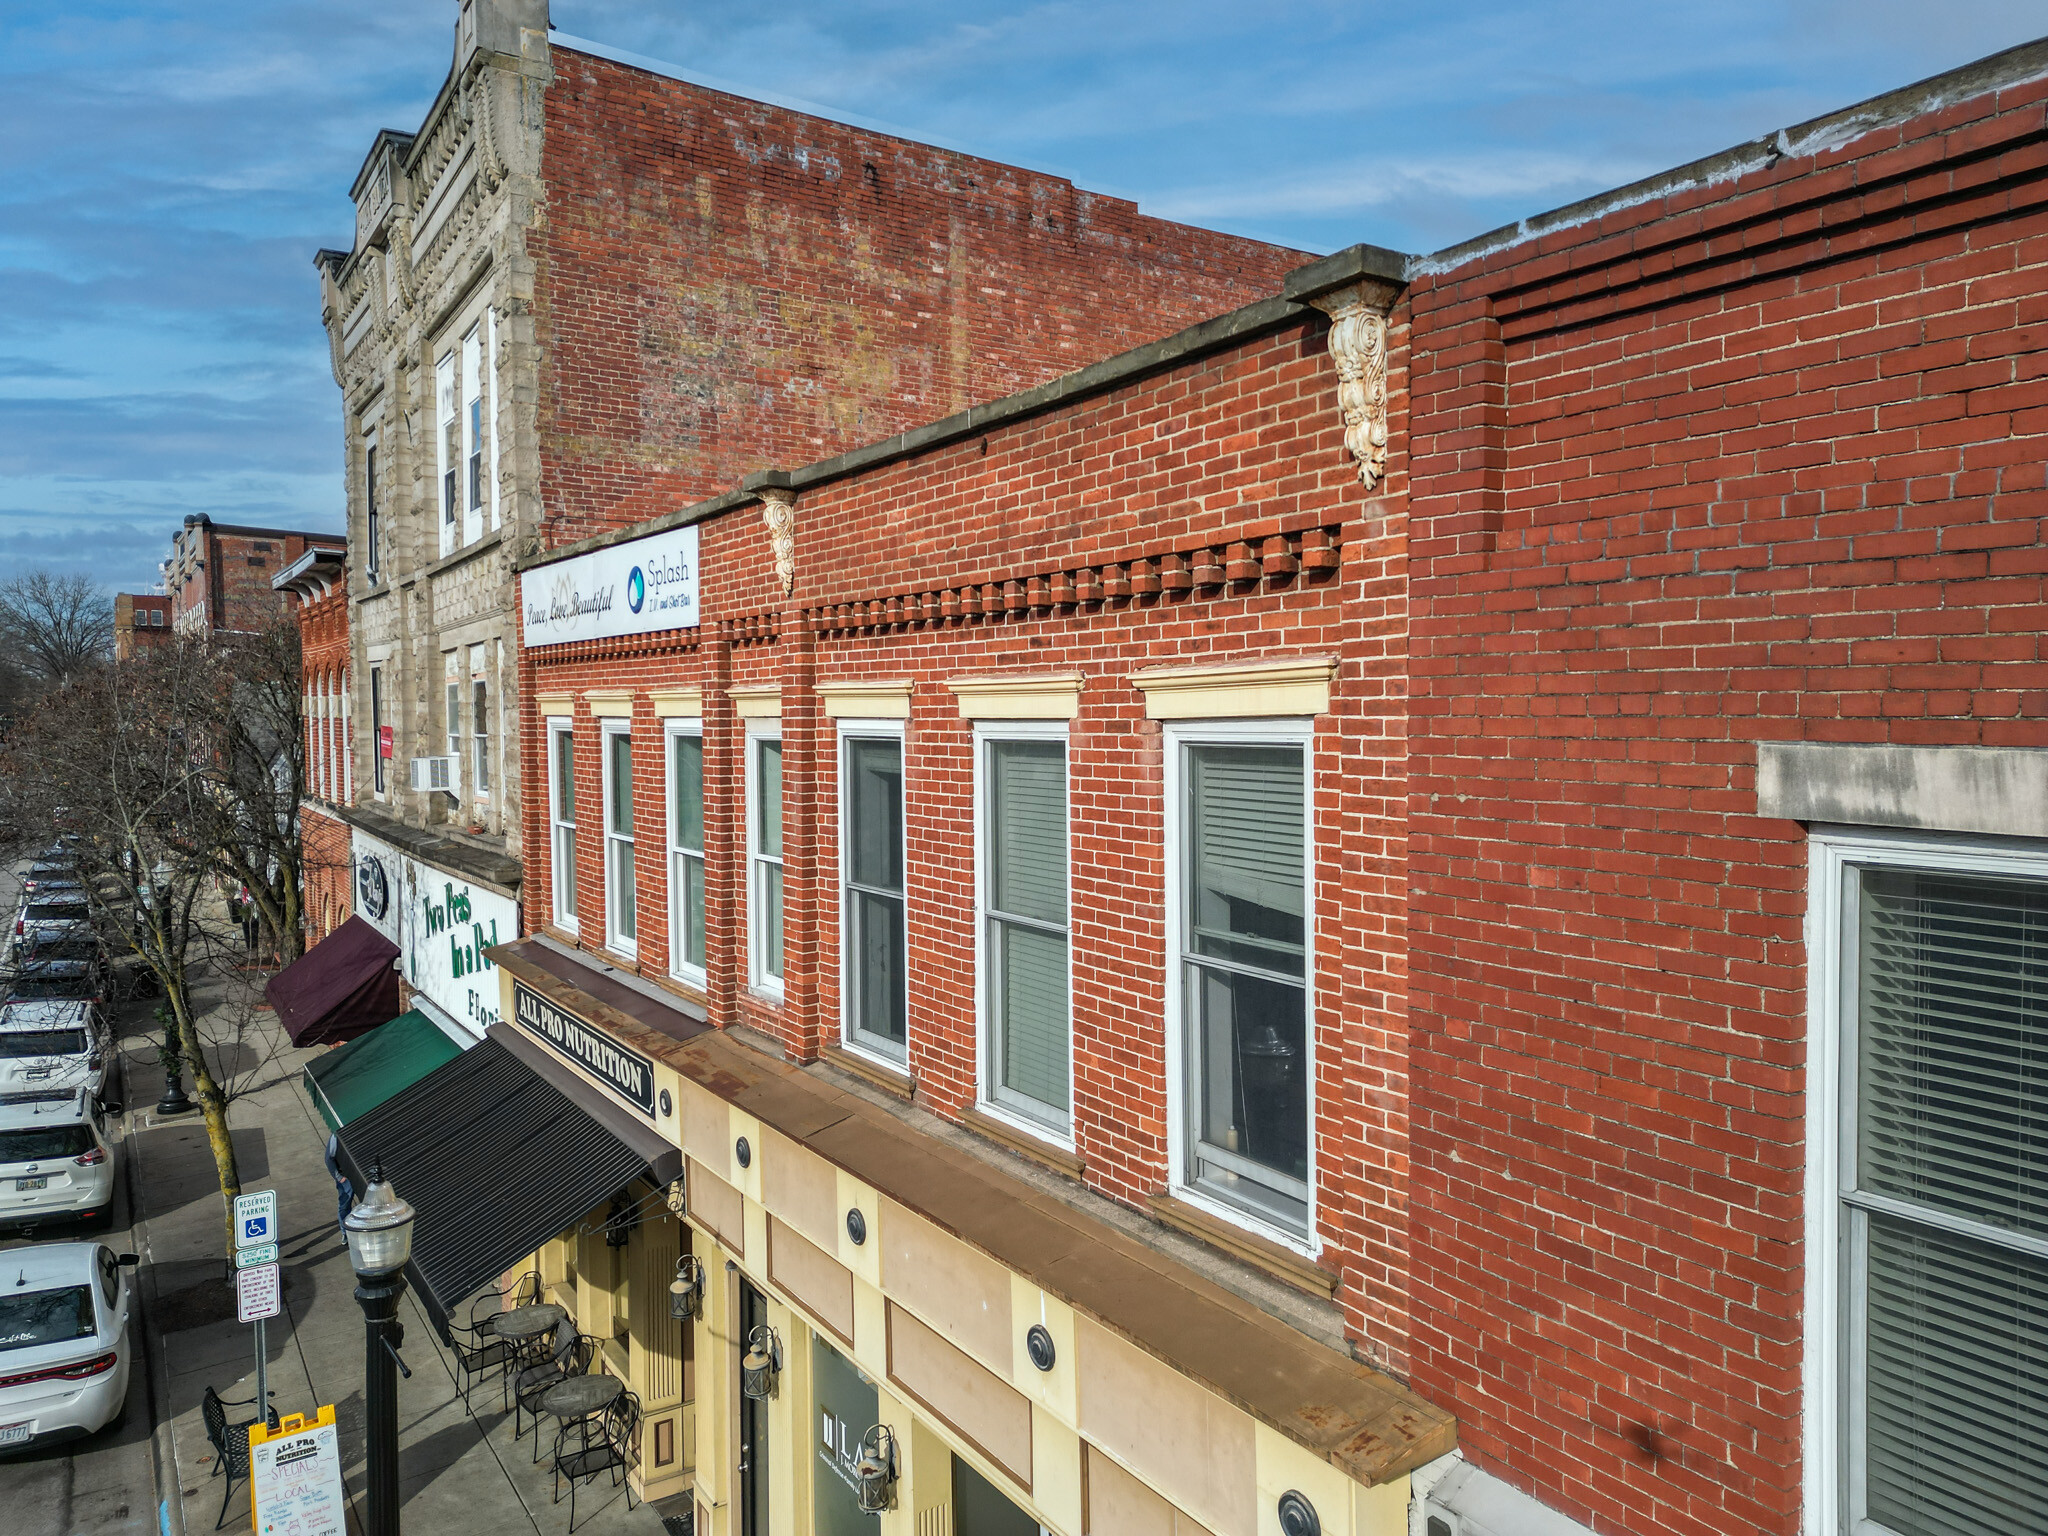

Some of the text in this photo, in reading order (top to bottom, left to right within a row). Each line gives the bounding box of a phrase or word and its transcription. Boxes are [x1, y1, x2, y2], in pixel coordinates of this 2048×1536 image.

[648, 551, 690, 594] Splash
[526, 584, 615, 627] Peace, Love, Beautiful
[422, 896, 445, 938] Two
[519, 991, 642, 1097] ALL PRO NUTRITION
[239, 1196, 271, 1208] RESERVED
[241, 1205, 270, 1217] PARKING
[244, 1254, 270, 1264] MINIMUM
[259, 1248, 272, 1256] FINE
[276, 1441, 294, 1456] ALL
[296, 1438, 315, 1449] PRO
[276, 1445, 317, 1463] NUTRITION
[271, 1456, 319, 1481] SPECIALS
[275, 1484, 312, 1502] LOCAL
